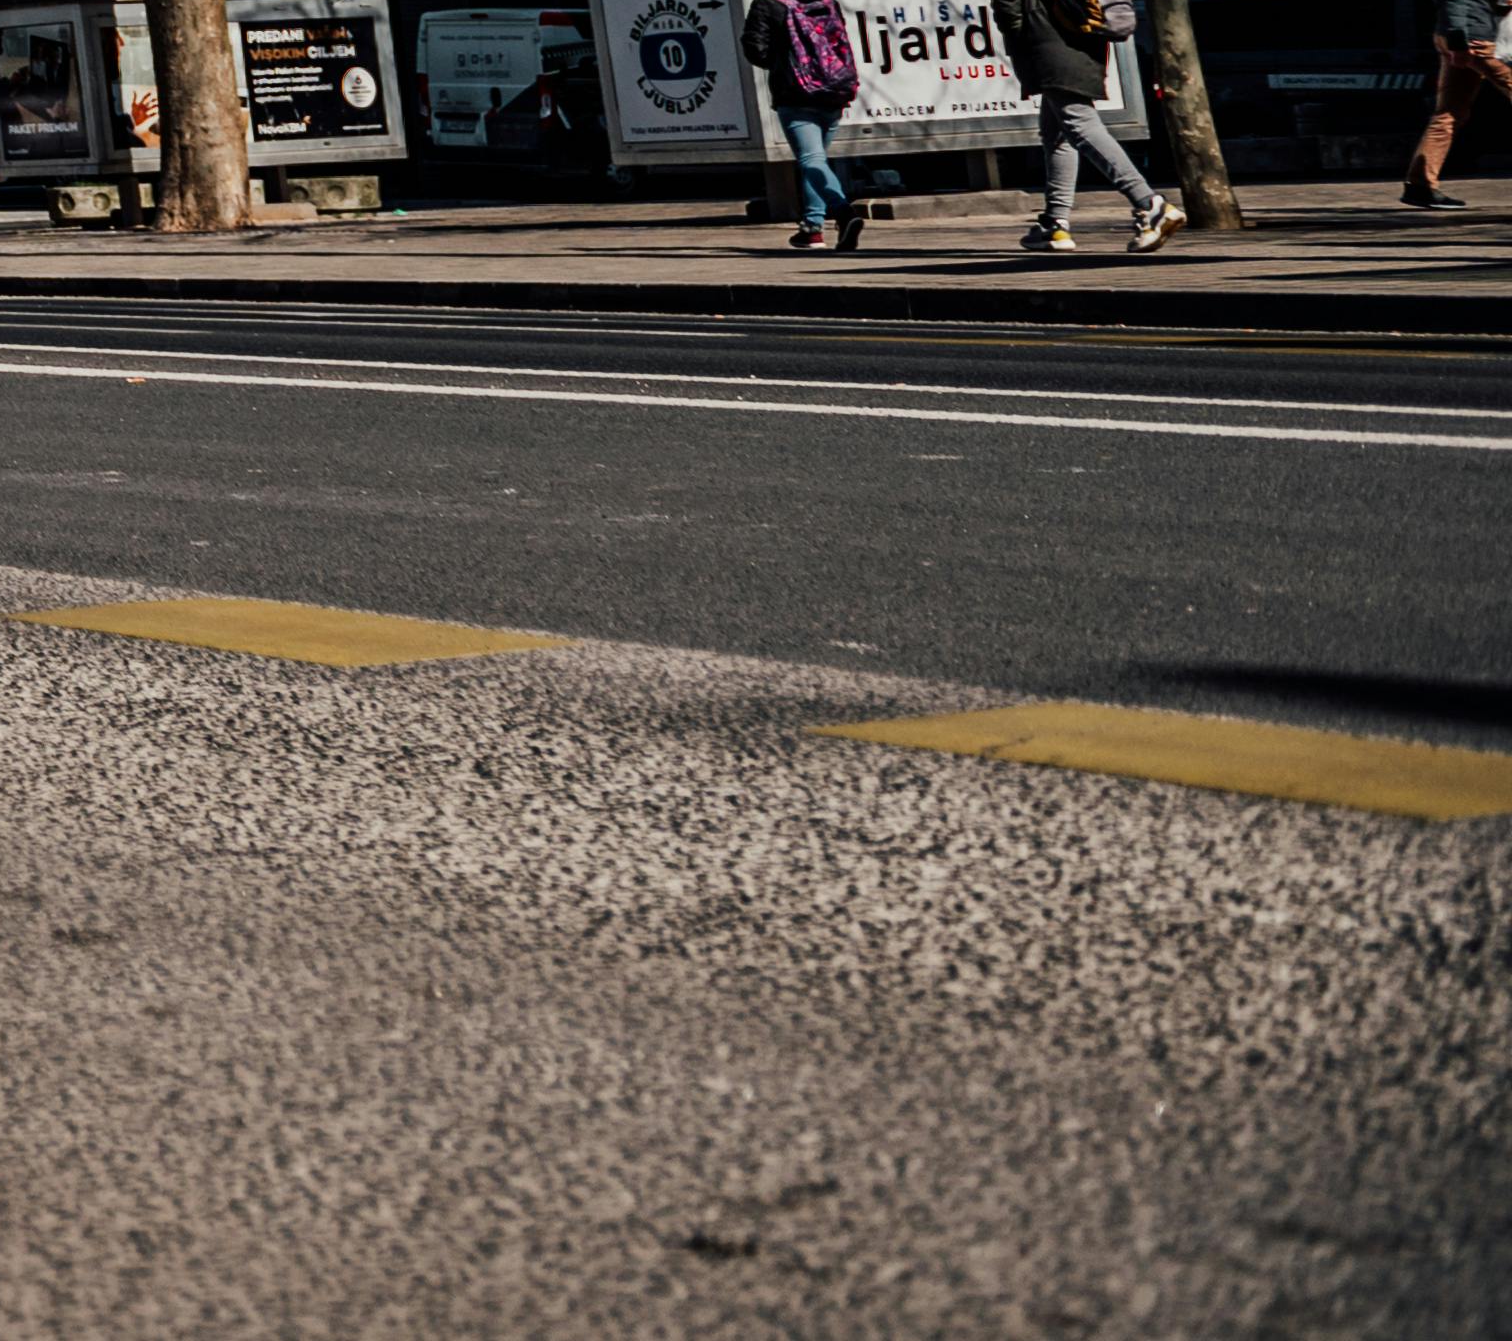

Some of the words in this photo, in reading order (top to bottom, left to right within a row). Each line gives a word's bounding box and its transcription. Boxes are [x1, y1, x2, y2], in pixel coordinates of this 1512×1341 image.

[629, 0, 709, 43] BILJARDNA
[892, 1, 975, 23] HIŠA
[855, 5, 996, 74] ljard
[663, 45, 683, 68] 10
[940, 65, 1011, 80] LJUBL
[637, 70, 717, 114] LJUBLJANA
[866, 105, 936, 118] KADILCEM
[952, 101, 1018, 113] PRIJAZEN
